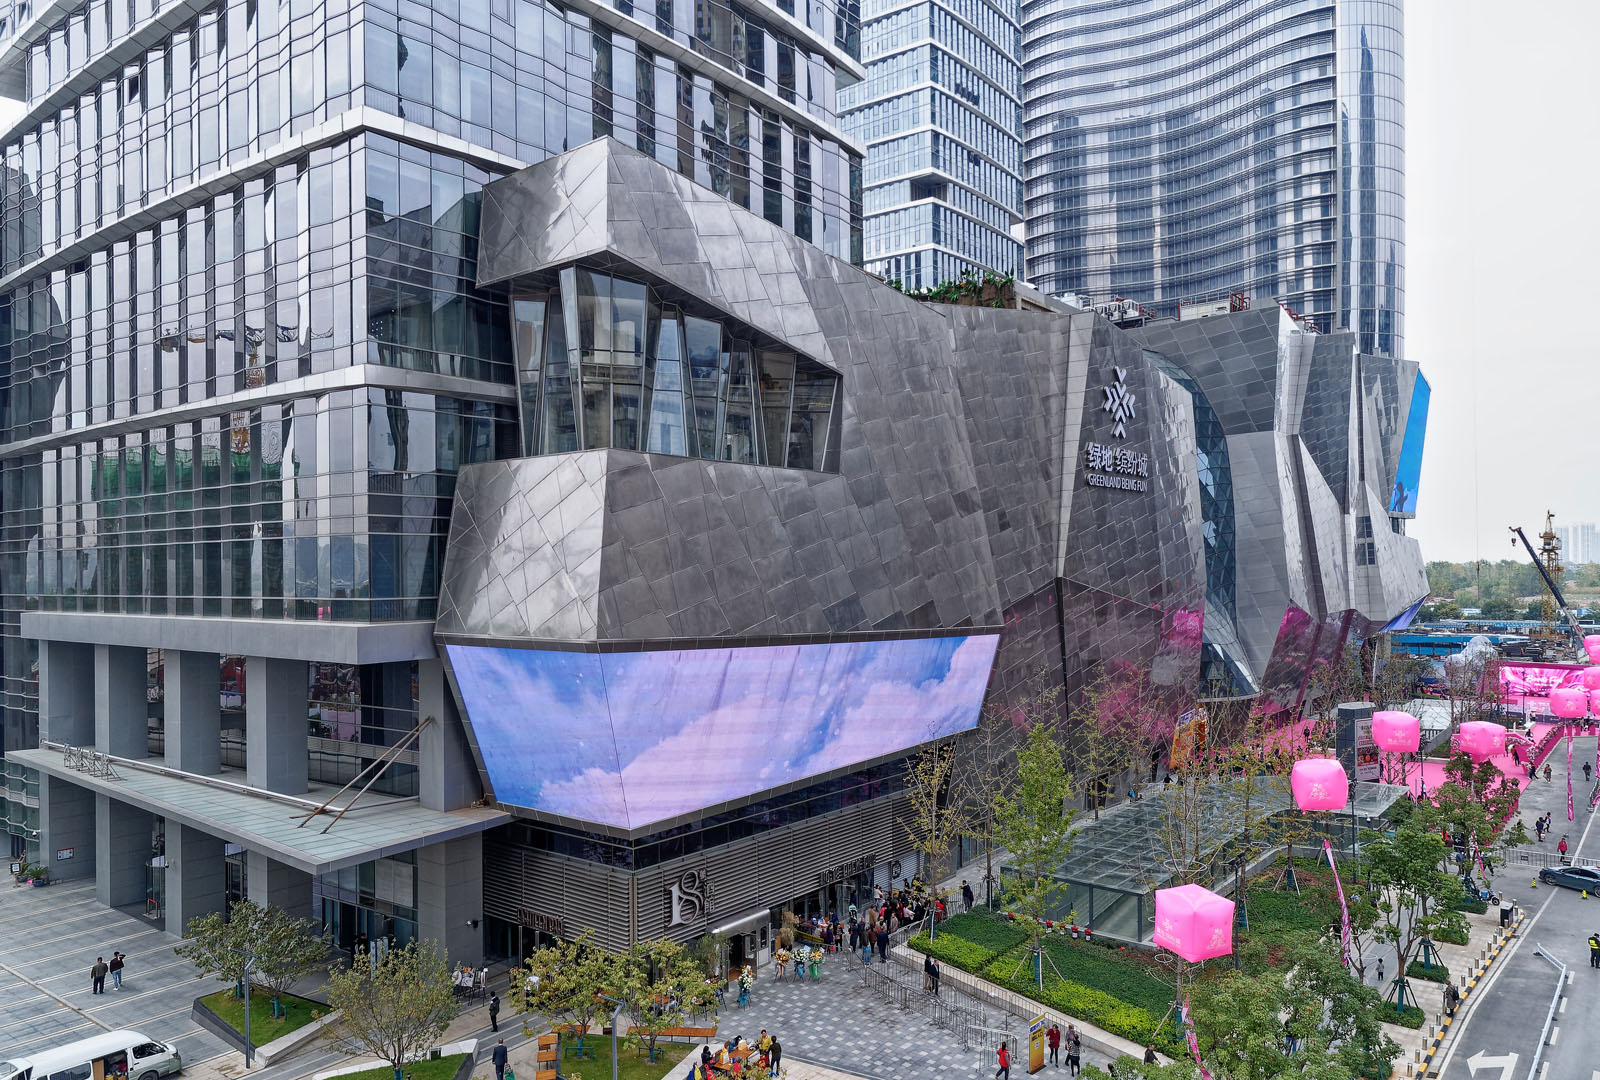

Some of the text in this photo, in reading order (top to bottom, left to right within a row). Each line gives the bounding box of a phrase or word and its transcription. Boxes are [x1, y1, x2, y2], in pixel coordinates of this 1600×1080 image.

[1087, 442, 1148, 477] 绿地 缤纷城
[1088, 473, 1148, 492] GREENLAND BEING FUN
